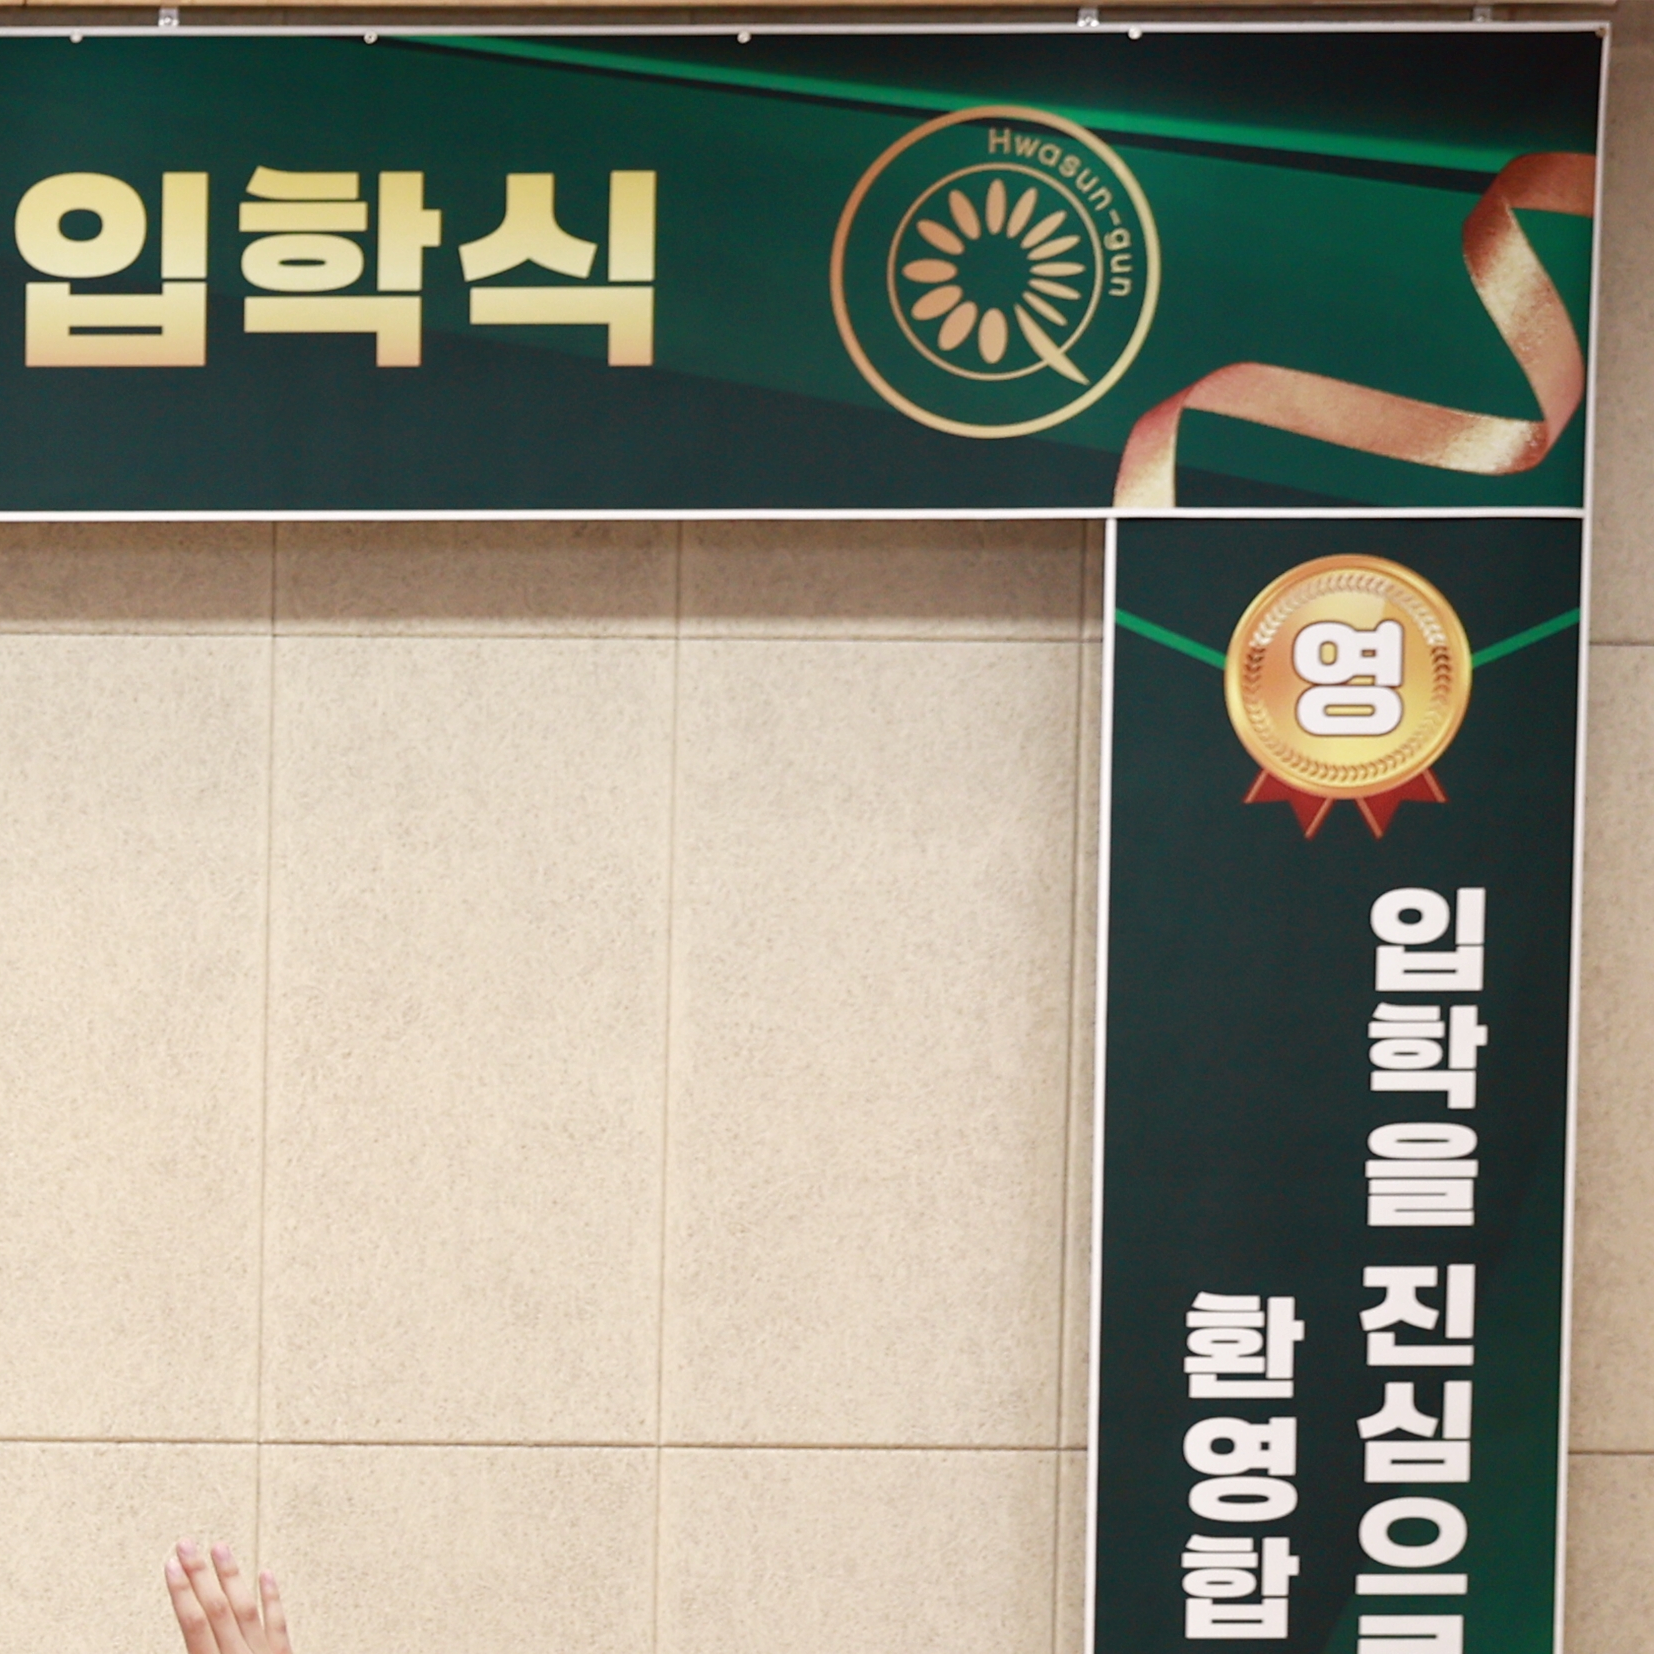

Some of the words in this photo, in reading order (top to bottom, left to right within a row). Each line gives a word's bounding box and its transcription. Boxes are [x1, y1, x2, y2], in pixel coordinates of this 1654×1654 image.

[14, 166, 657, 368] 입학식
[988, 127, 1131, 298] Hwasun-gun
[1293, 619, 1403, 736] 영
[1365, 887, 1488, 1226] 입학을
